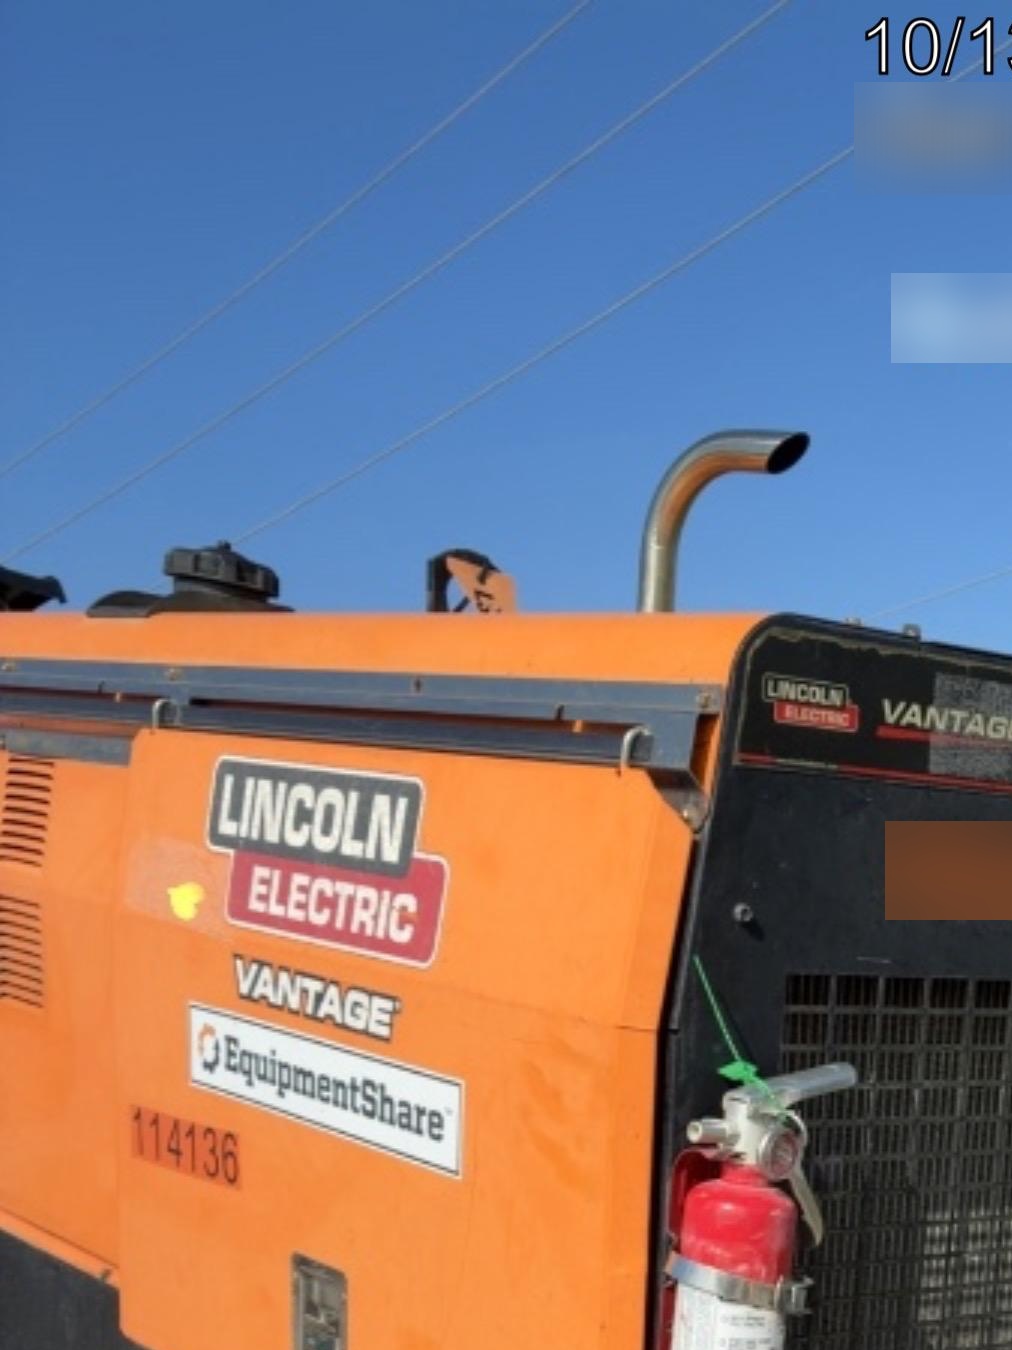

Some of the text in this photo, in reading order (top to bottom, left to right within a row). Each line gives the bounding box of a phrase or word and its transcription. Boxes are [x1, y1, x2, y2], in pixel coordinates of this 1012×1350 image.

[767, 679, 845, 707] LINCOLN
[784, 703, 850, 728] ELECTRIC
[217, 773, 408, 865] LINCOLN
[247, 866, 418, 944] ELECTRIC
[233, 954, 398, 1042] VANTAGE
[224, 1034, 446, 1143] EquipmentShare
[133, 1106, 240, 1186] 114136
